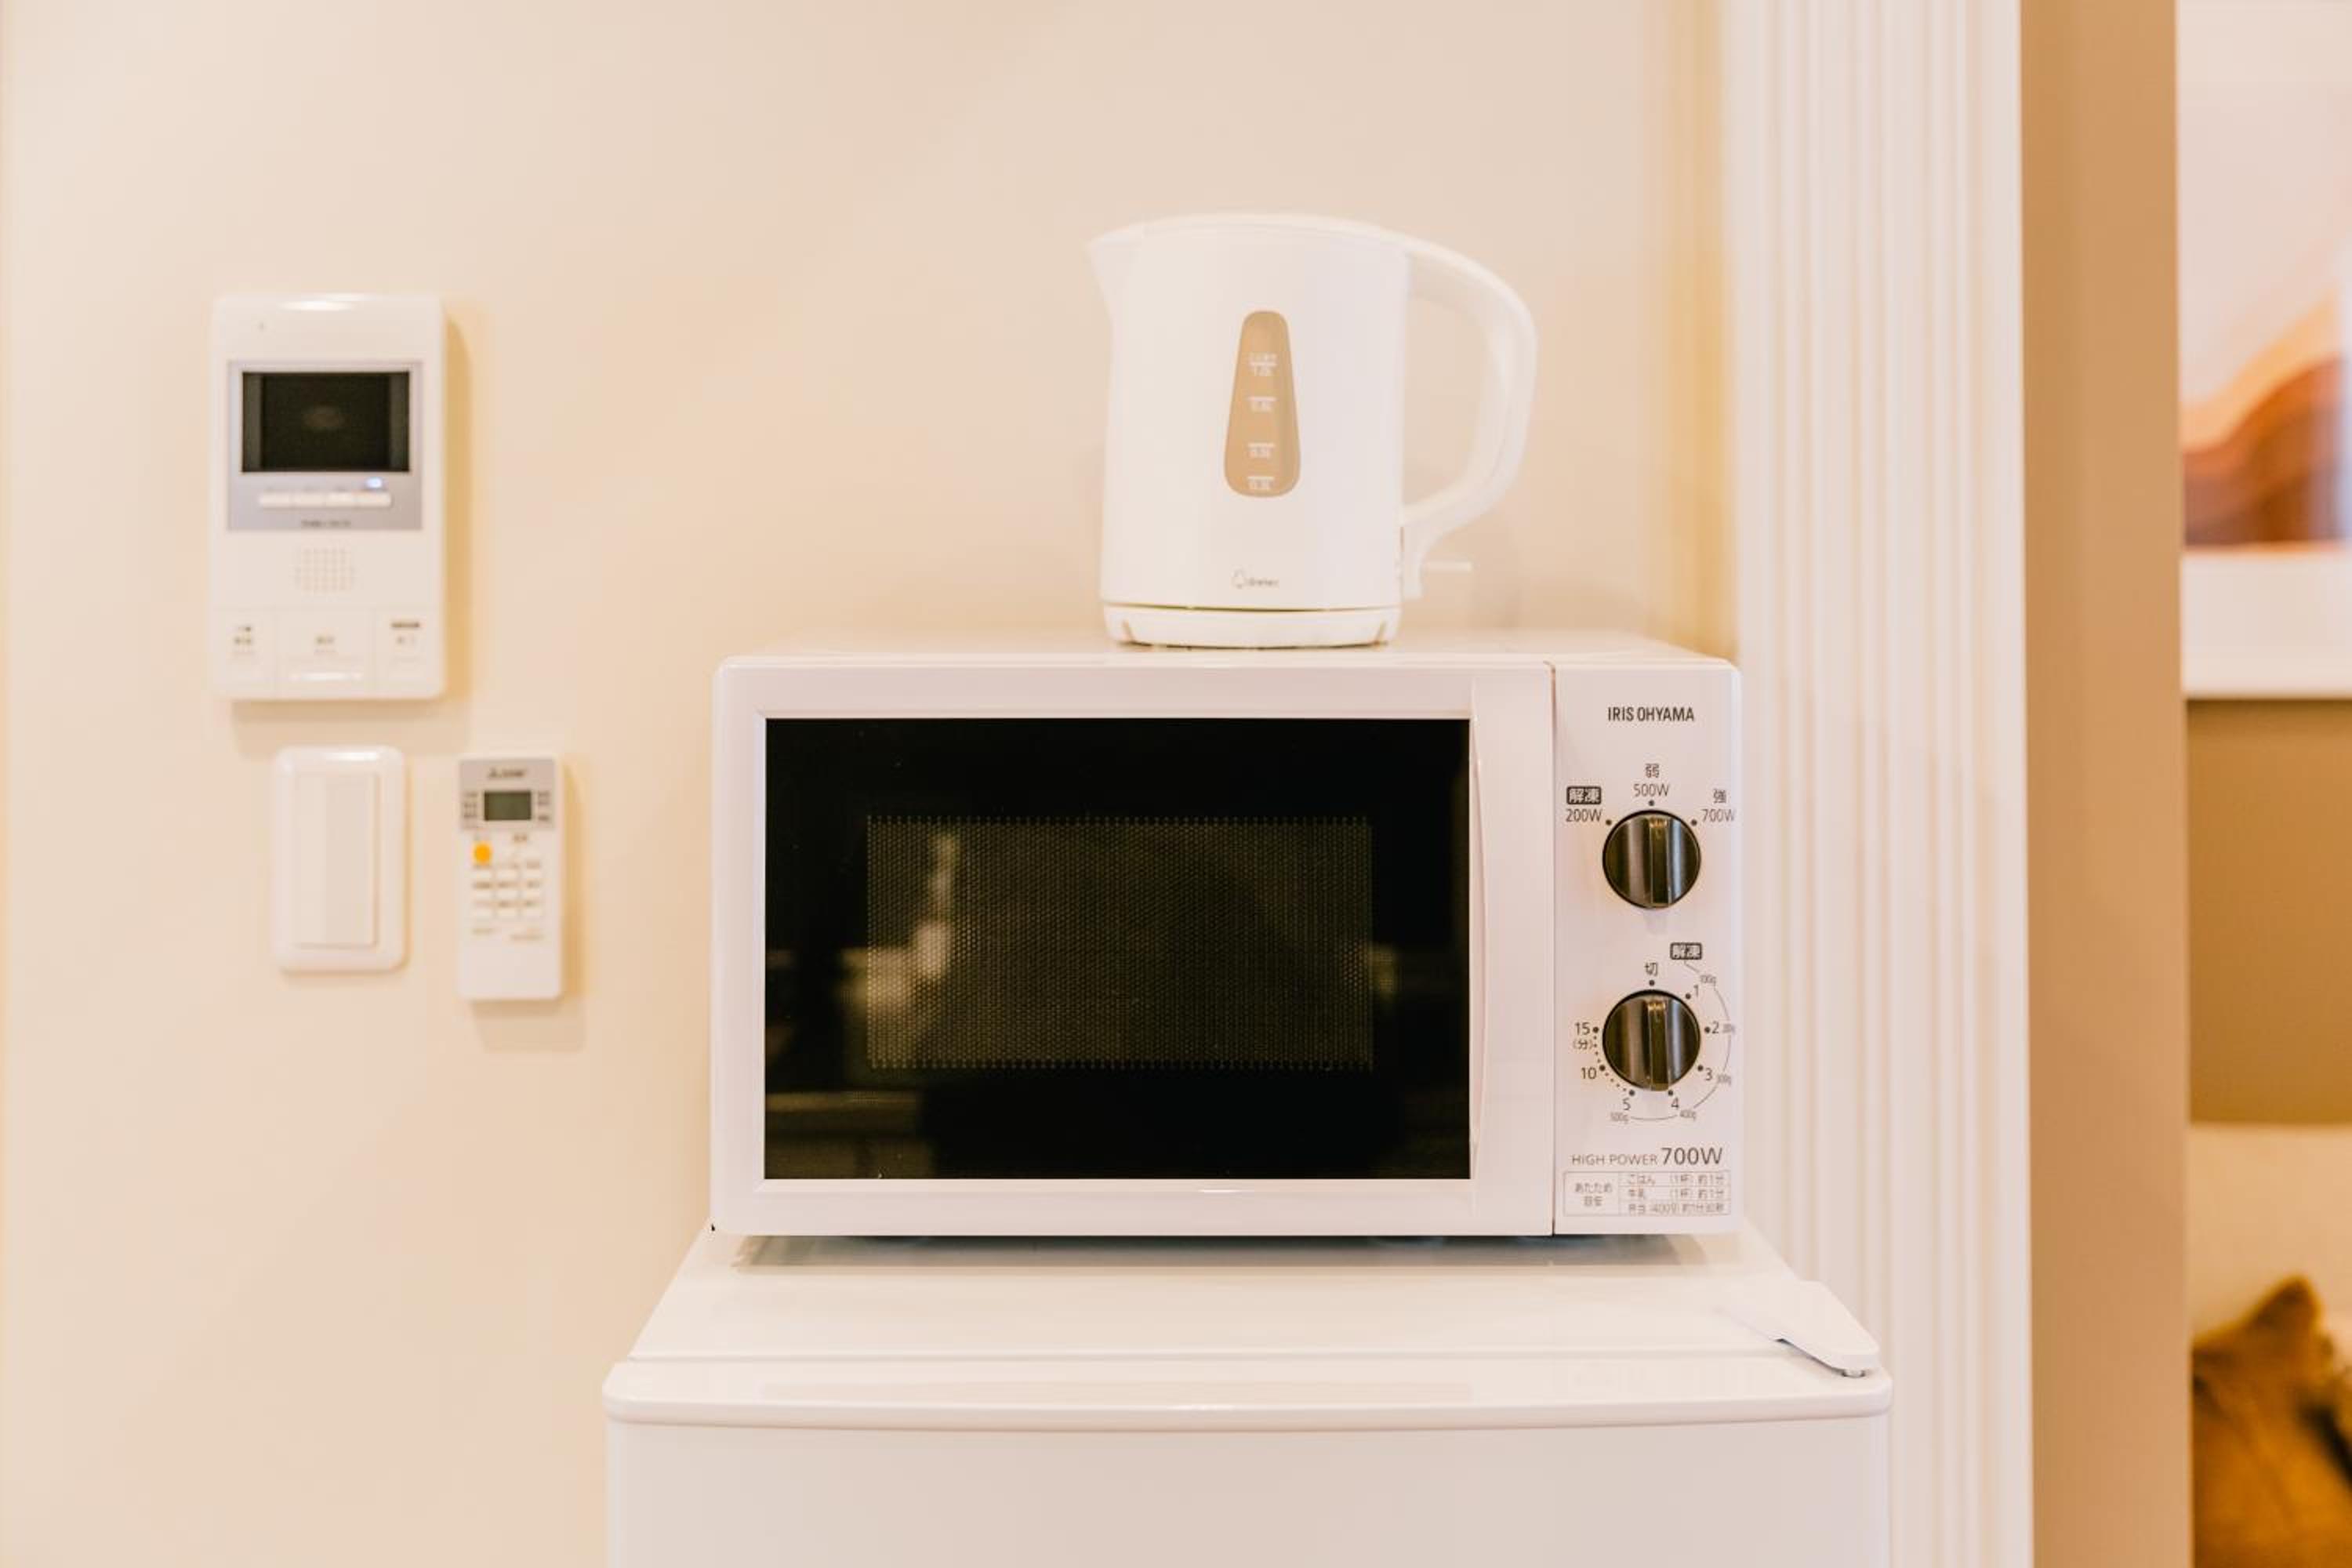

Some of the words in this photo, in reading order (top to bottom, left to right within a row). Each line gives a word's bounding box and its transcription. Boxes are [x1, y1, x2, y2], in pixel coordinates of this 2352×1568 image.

[1607, 706, 1634, 722] IRIS
[1637, 706, 1695, 722] OHYAMA
[1645, 763, 1660, 779] 弱
[1633, 784, 1670, 797] 500W
[1566, 808, 1602, 822] 200W
[1702, 808, 1736, 822] 700W
[1645, 962, 1658, 977] 切
[1693, 985, 1699, 996] 1
[1574, 1022, 1590, 1035] 15
[1711, 1021, 1719, 1034] 2
[1581, 1067, 1597, 1080] 10
[1705, 1067, 1713, 1081] 3
[1622, 1098, 1631, 1111] 5
[1671, 1098, 1679, 1110] 4
[1571, 1154, 1605, 1166] HIGH
[1610, 1154, 1658, 1166] POWER
[1661, 1147, 1722, 1166] 700W
